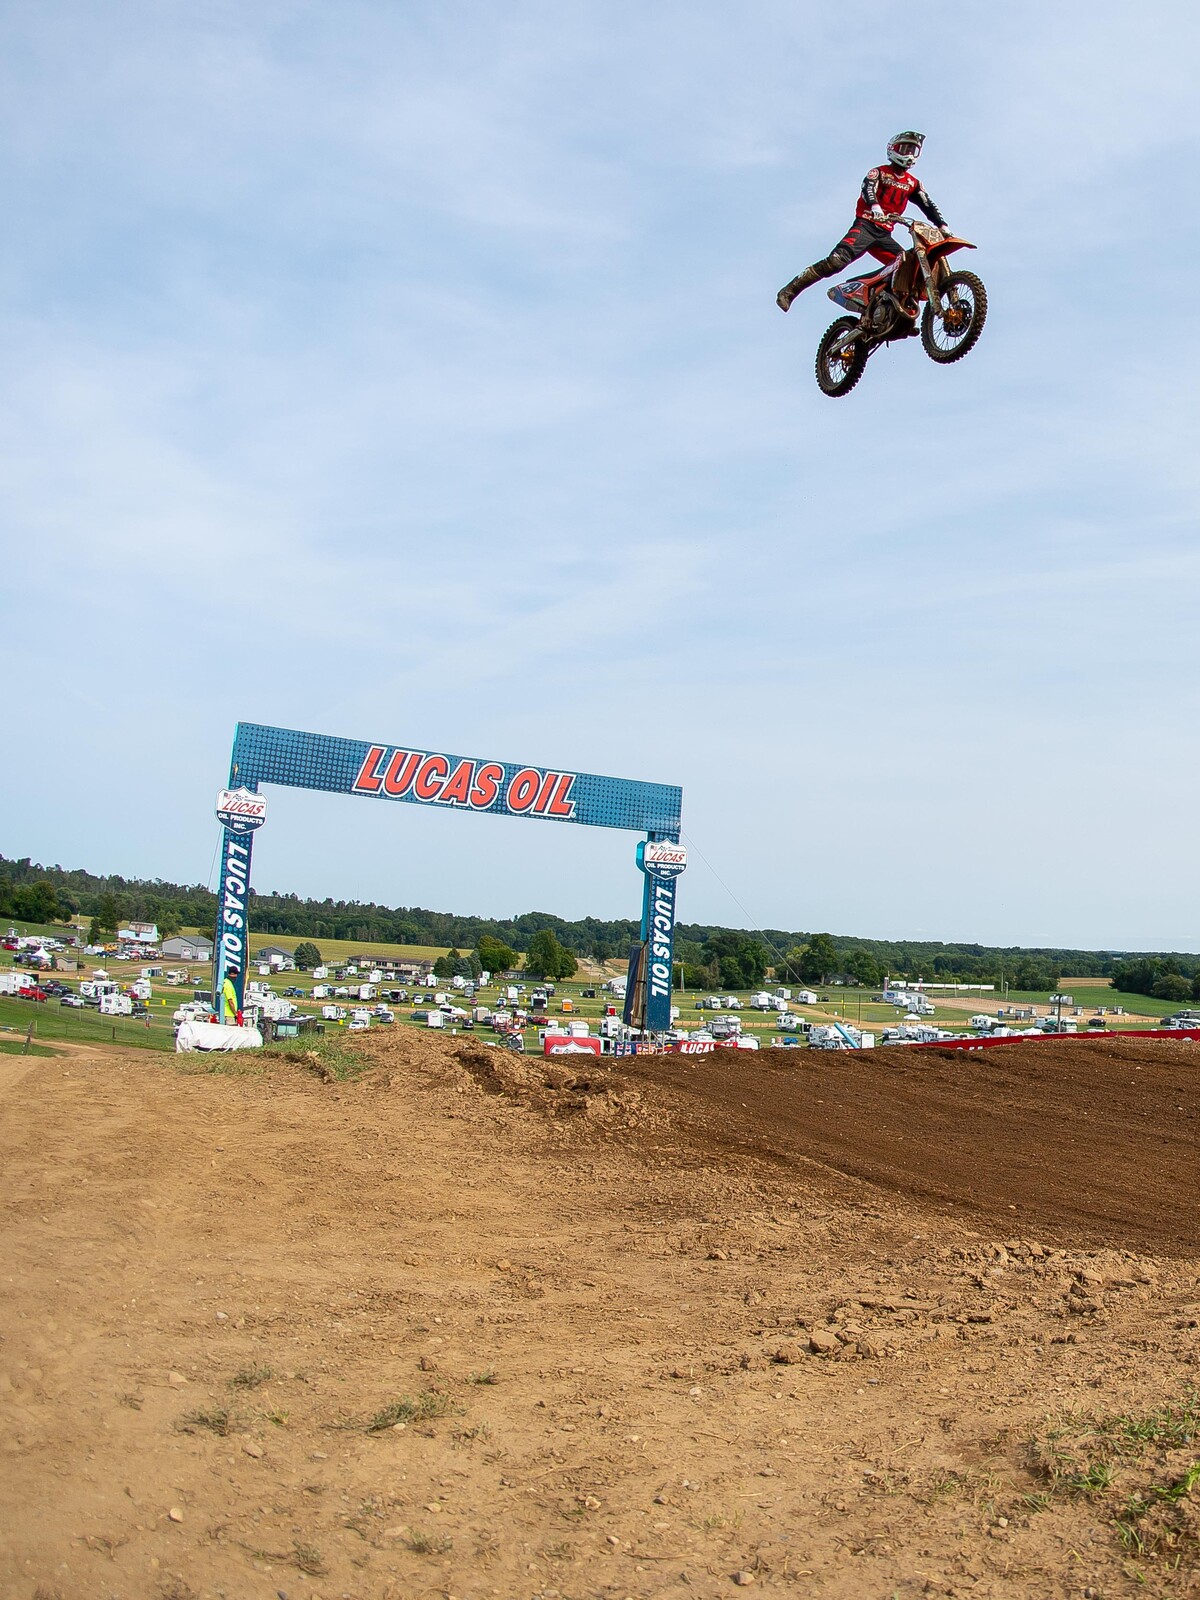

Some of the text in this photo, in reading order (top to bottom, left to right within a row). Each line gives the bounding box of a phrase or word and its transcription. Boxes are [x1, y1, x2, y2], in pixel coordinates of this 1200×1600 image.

[352, 745, 575, 818] LUCAS OIL
[222, 801, 264, 815] LUCAS
[230, 814, 263, 824] PRODUCTS
[650, 851, 685, 863] LUCAS
[224, 841, 248, 929] LUCAS
[651, 886, 673, 997] LUCAS OIL
